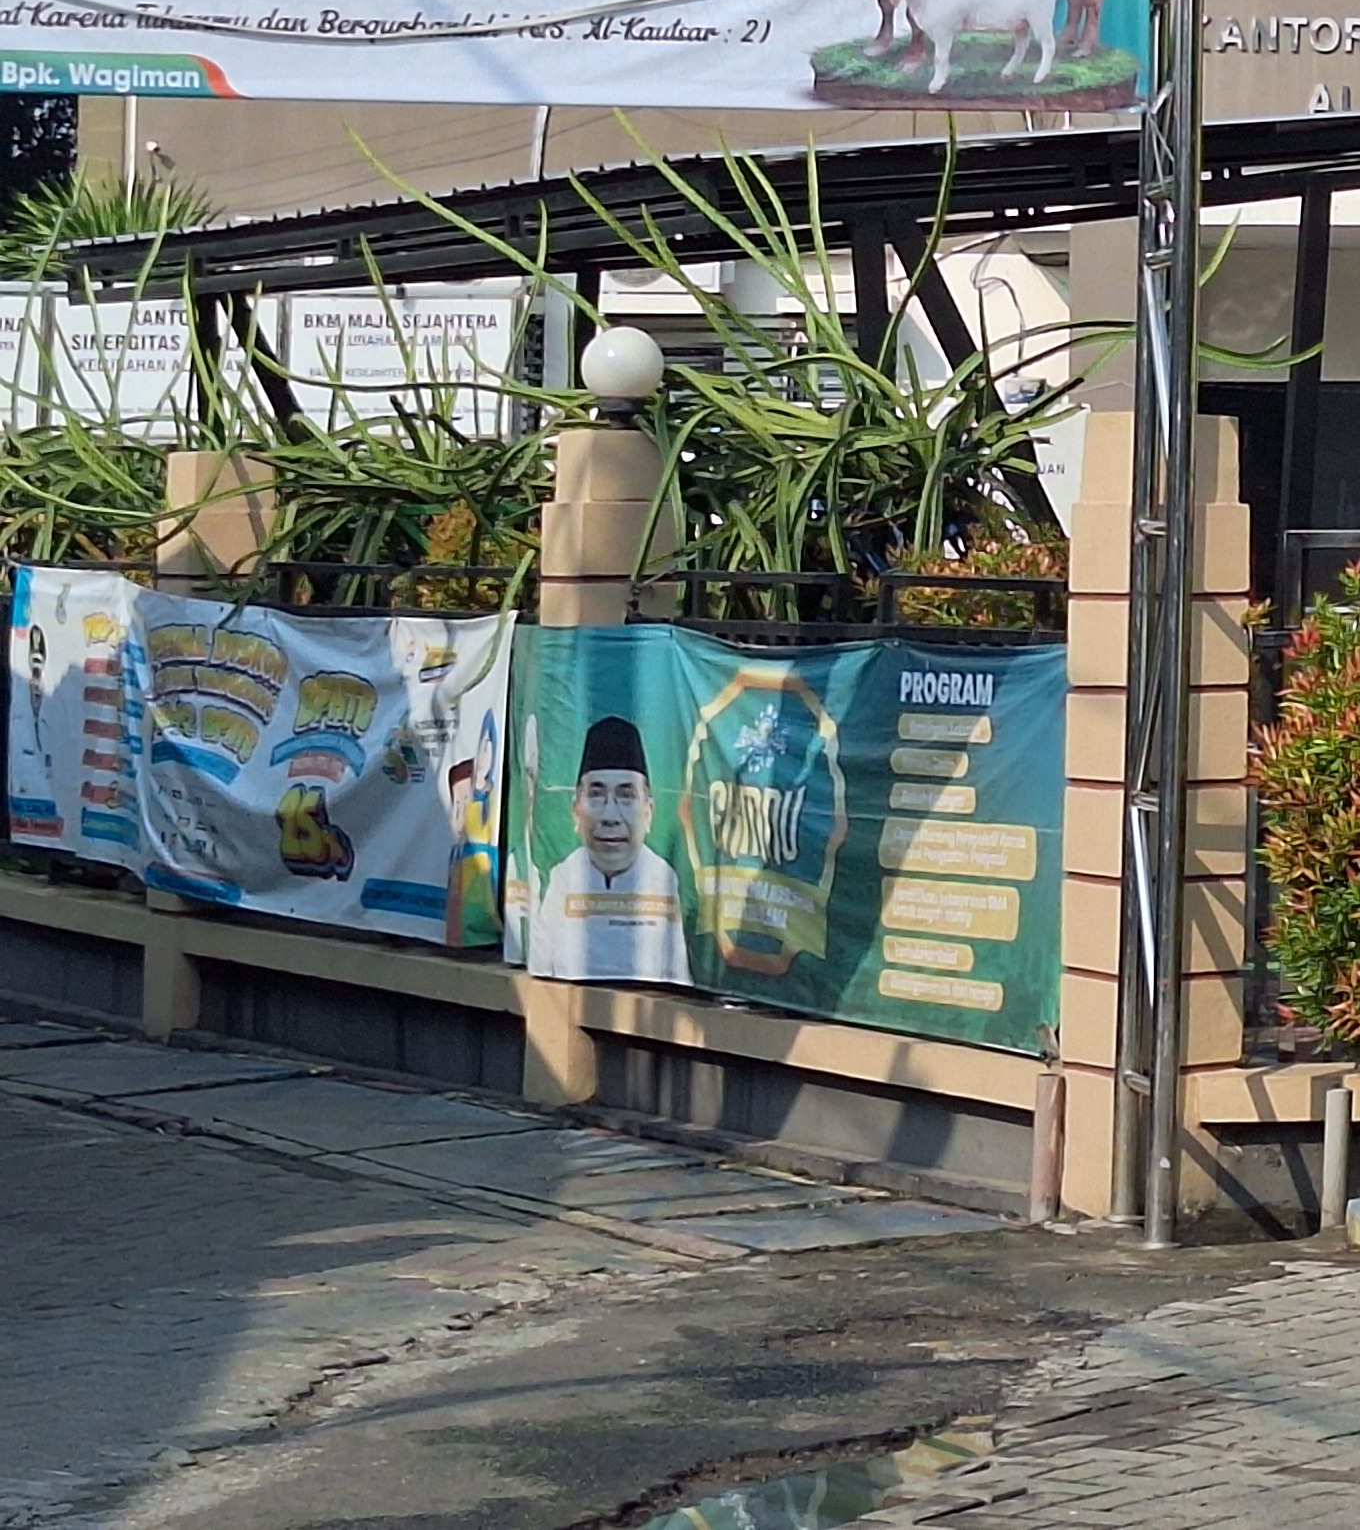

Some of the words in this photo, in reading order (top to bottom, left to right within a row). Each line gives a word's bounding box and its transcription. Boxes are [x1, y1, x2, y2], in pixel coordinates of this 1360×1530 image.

[30, 0, 129, 30] Karena
[257, 7, 310, 32] dan
[582, 15, 720, 43] Al-Kautsar
[2, 61, 60, 90] Bpk.
[69, 63, 200, 93] Wagiman
[303, 313, 341, 329] BKM
[900, 670, 994, 706] PROGRAM
